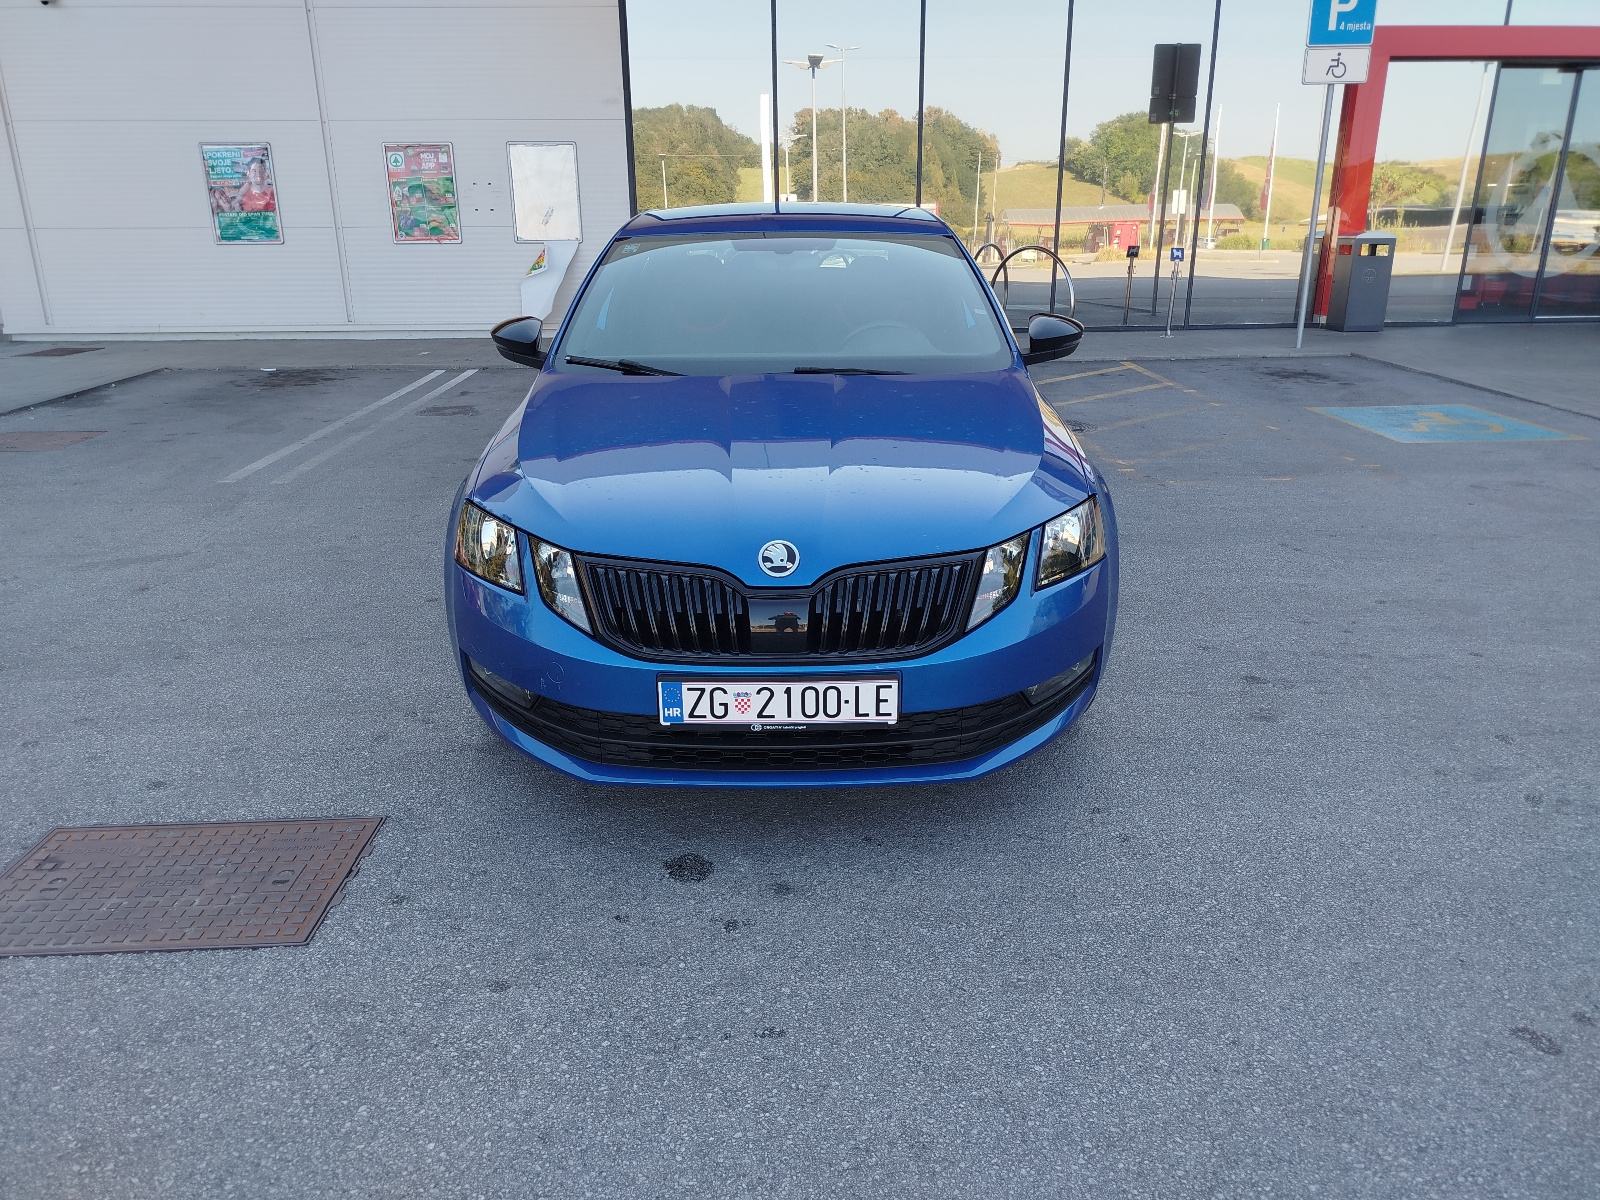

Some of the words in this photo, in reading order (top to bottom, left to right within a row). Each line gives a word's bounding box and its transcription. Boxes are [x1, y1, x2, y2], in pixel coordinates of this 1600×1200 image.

[1339, 21, 1345, 31] 4
[1346, 21, 1371, 32] mjesta
[686, 687, 729, 719] ZG
[664, 707, 681, 718] HR
